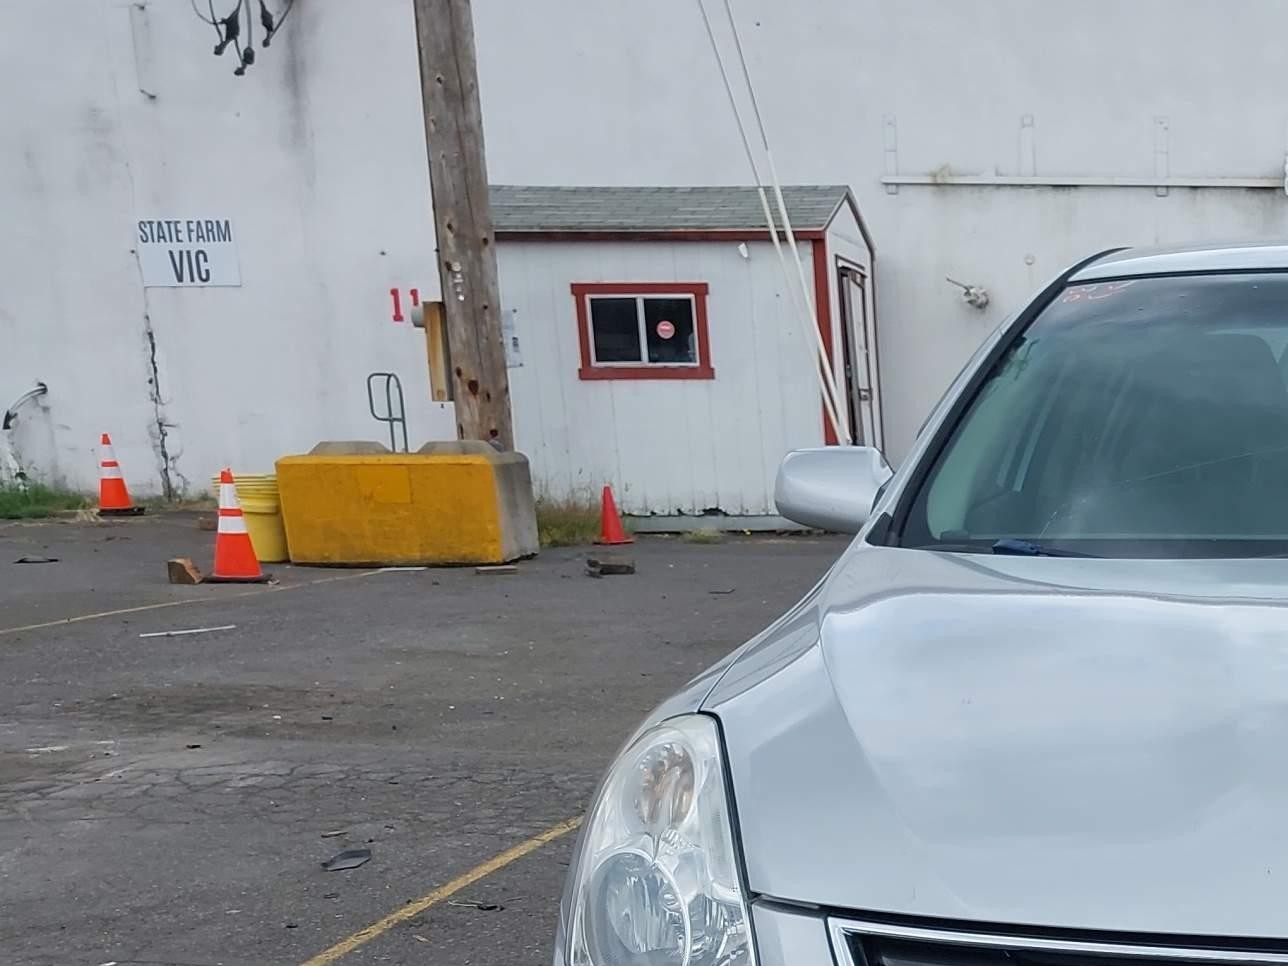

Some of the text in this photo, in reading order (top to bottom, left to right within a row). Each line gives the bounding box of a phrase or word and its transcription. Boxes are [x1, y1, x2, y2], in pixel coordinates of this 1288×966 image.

[138, 220, 232, 243] STATE FARM
[168, 249, 211, 283] VIC
